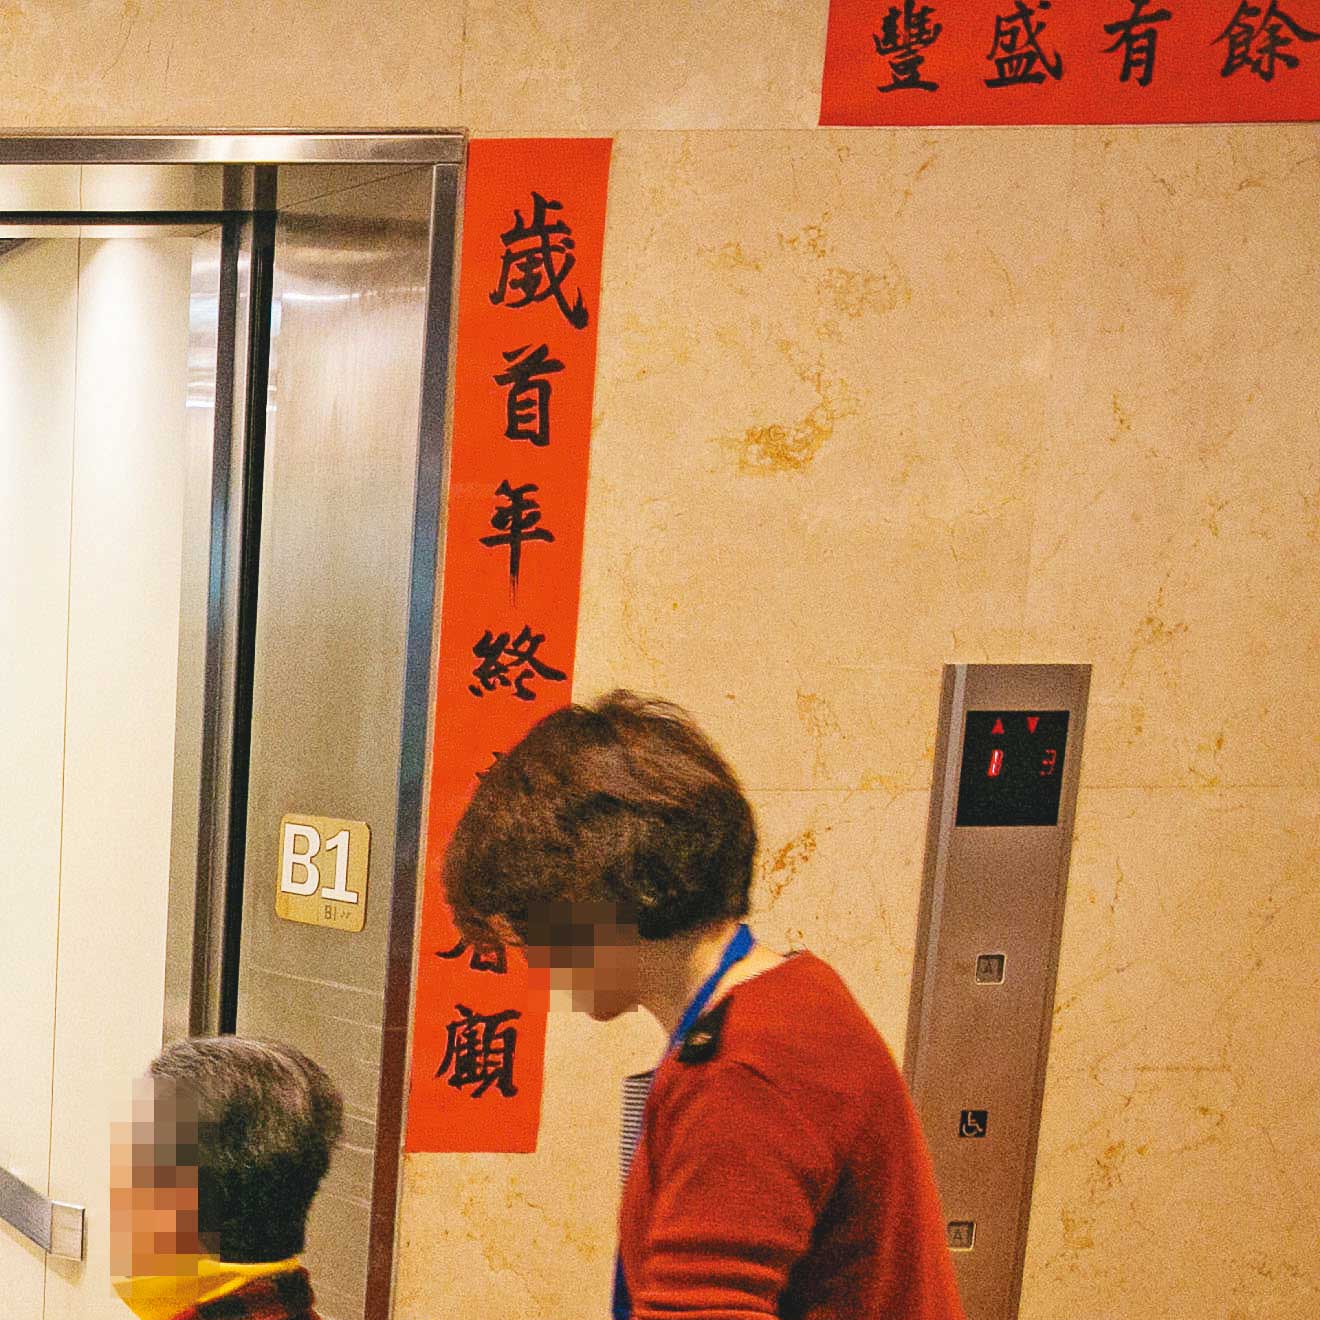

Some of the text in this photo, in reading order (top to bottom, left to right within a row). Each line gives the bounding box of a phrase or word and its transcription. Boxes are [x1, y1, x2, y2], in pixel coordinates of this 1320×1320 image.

[874, 0, 1320, 93] 豐盛有餘
[434, 191, 589, 1099] 歲首年終顧
[281, 822, 359, 904] B1
